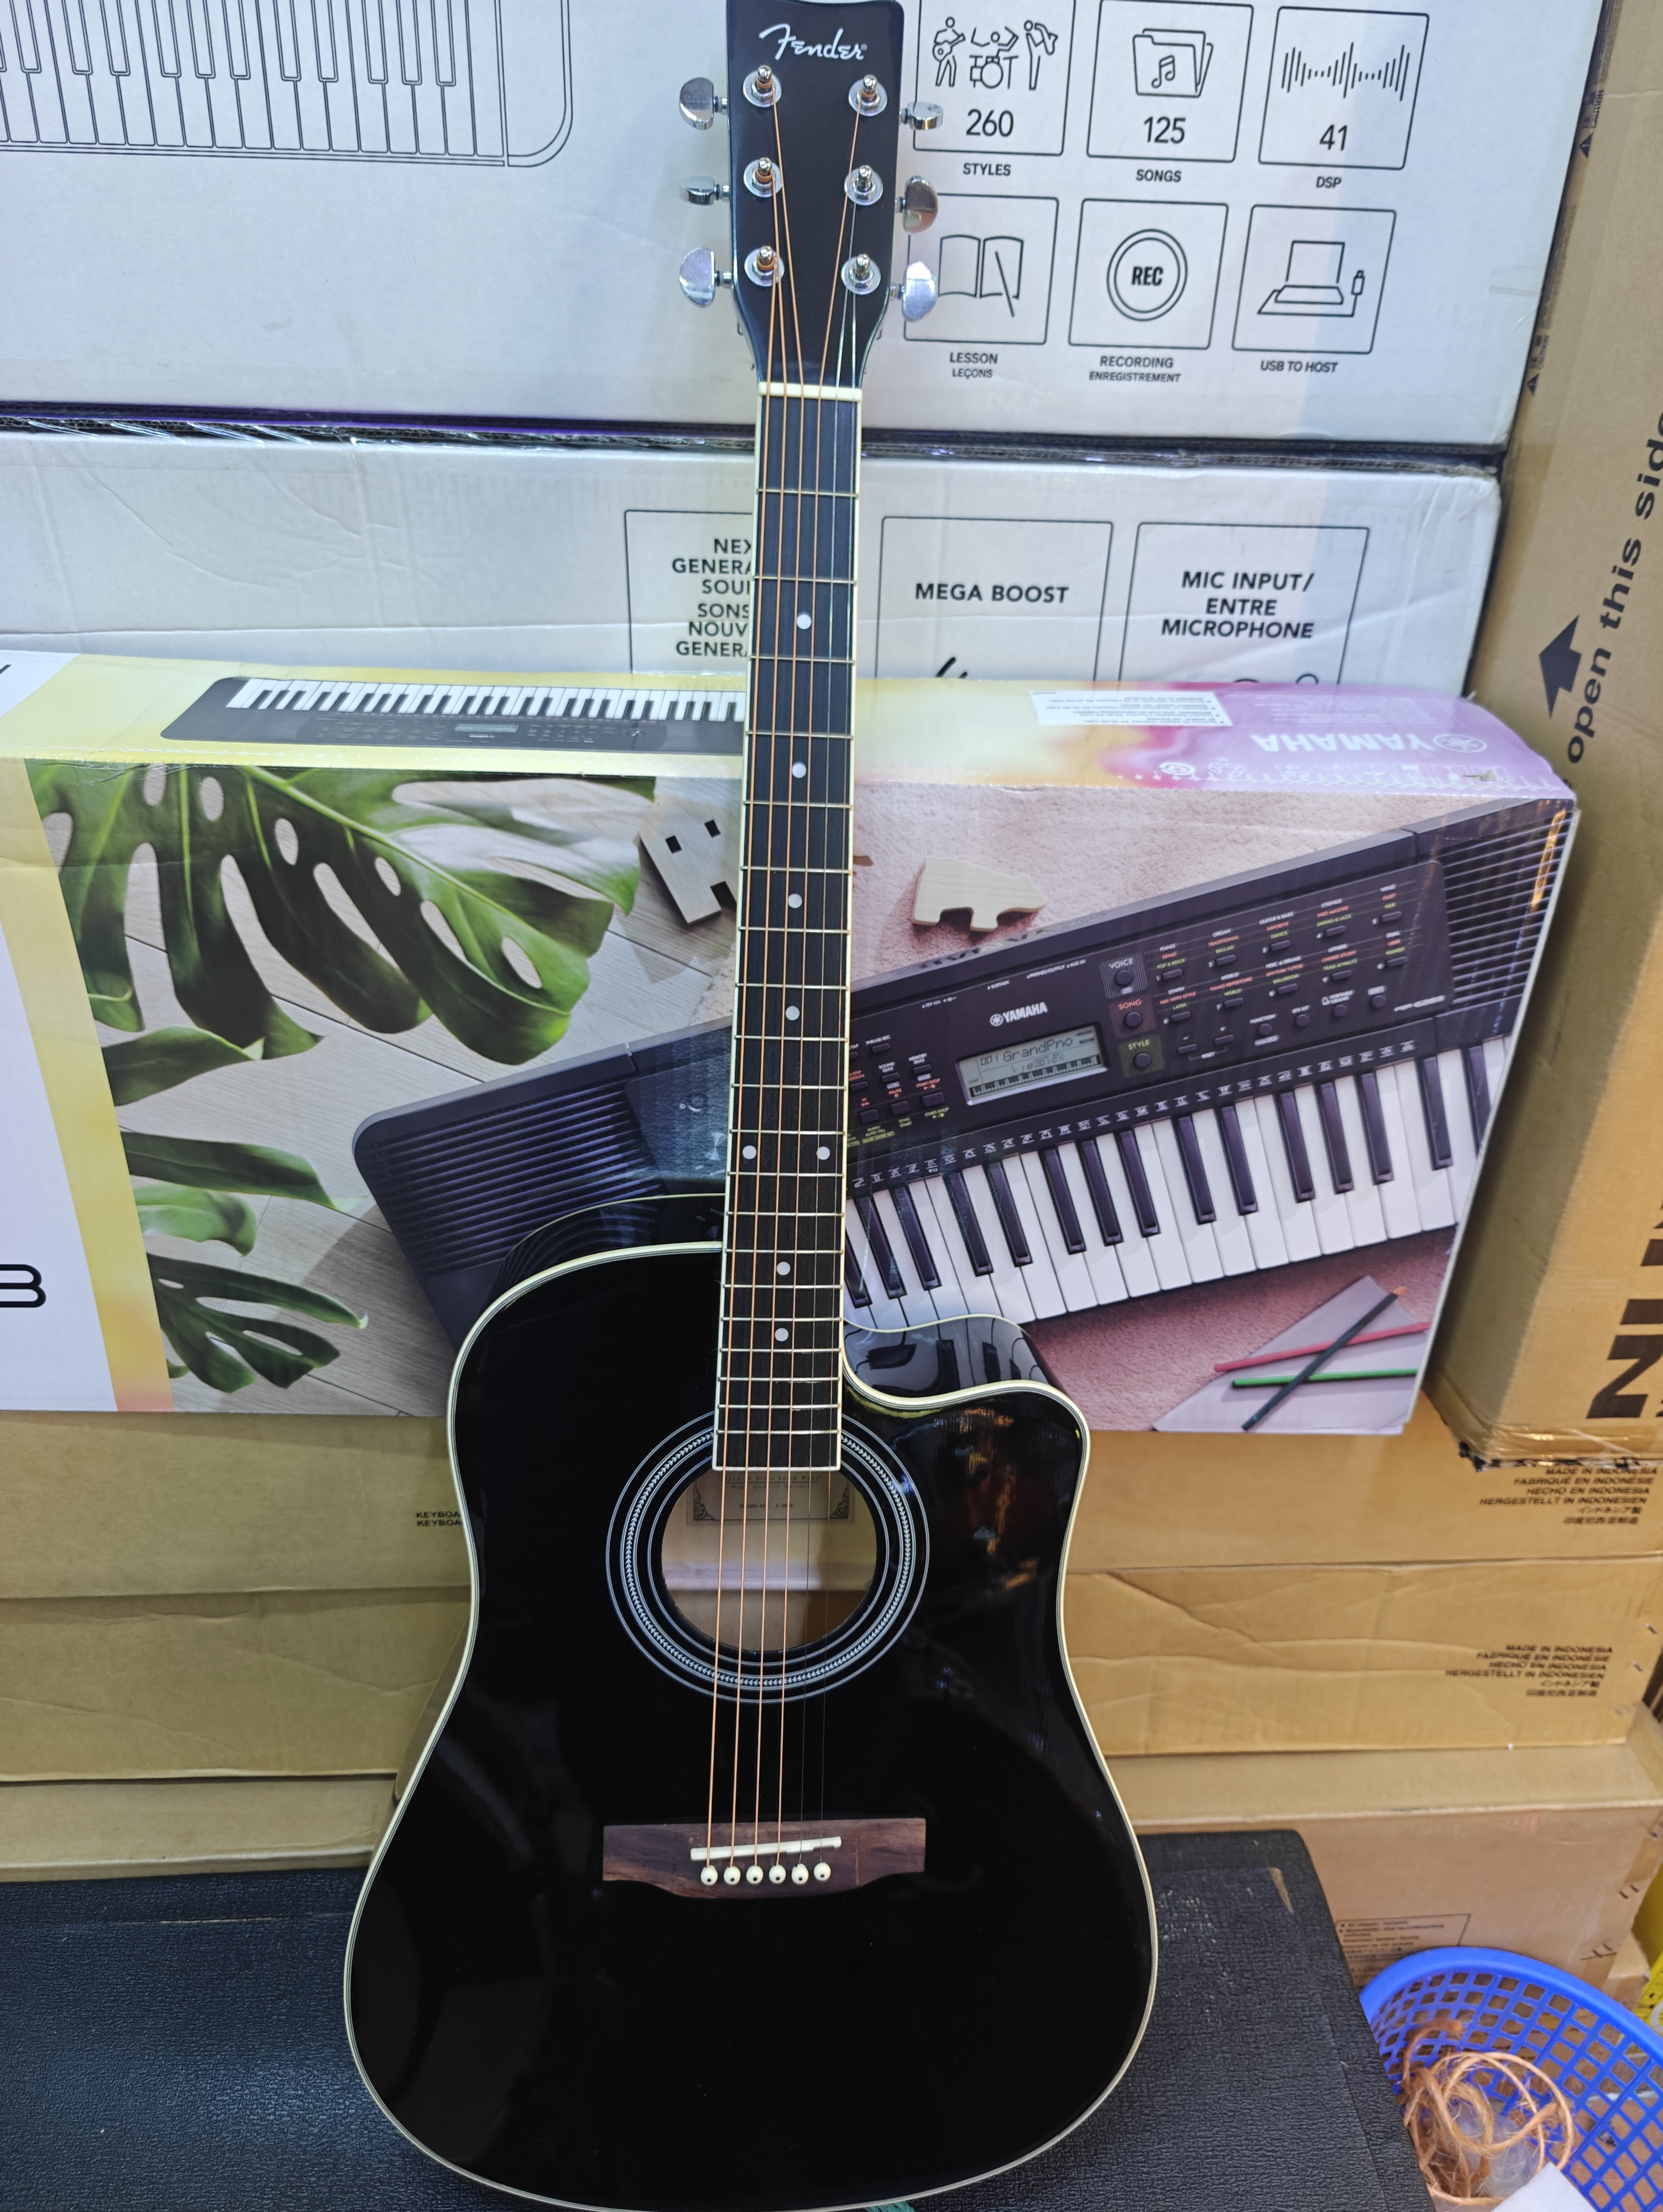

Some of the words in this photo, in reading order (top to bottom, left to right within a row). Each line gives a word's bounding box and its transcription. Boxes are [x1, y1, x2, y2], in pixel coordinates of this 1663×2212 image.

[759, 23, 864, 60] Fender
[966, 110, 1014, 137] 260
[1144, 116, 1186, 145] 125
[1319, 124, 1348, 151] 41
[963, 163, 1011, 177] STYLES
[1136, 169, 1182, 184] SONGS
[1316, 176, 1341, 189] DSP
[1131, 267, 1163, 287] REC
[949, 352, 998, 365] LESSON
[1100, 356, 1174, 369] RECORDING
[951, 368, 993, 379] LEÇONS
[1261, 360, 1290, 372] USB
[1293, 361, 1304, 373] TO
[1306, 361, 1338, 374] HOST
[1089, 371, 1181, 384] ENREGISTREMENT
[1181, 572, 1225, 589] MIC
[1232, 573, 1315, 592] INPUT/
[915, 583, 983, 601] MEGA
[991, 586, 1069, 603] BOOST
[1206, 598, 1277, 617] ENTRE
[1161, 619, 1314, 639] MICROPHONE
[1568, 649, 1611, 764] open
[1600, 538, 1641, 629] this
[1250, 733, 1436, 753] YAMAHA
[1282, 911, 1294, 920] BASS
[1212, 928, 1231, 937] ORGAN
[1270, 930, 1289, 939] DANCE
[1159, 943, 1176, 952] PIANO
[1207, 935, 1240, 947] TRADITIONAL
[1215, 944, 1235, 954] BALLAD
[1109, 958, 1133, 969] VOICE
[1220, 972, 1240, 980] WORLD
[1273, 973, 1300, 984] BALLROOM
[1168, 987, 1185, 995] SYNTH
[1210, 982, 1226, 991] PIANO
[1118, 999, 1142, 1010] SONG
[1002, 1001, 1048, 1023] YAMAHA
[1249, 1013, 1277, 1024] FUNCTION
[1003, 1037, 1073, 1062] GrandPno
[1128, 1039, 1150, 1050] STYLE
[916, 1078, 940, 1087] START/STOP
[924, 1107, 949, 1116] START/STOP
[1479, 1496, 1561, 1505] HERGESTELLT
